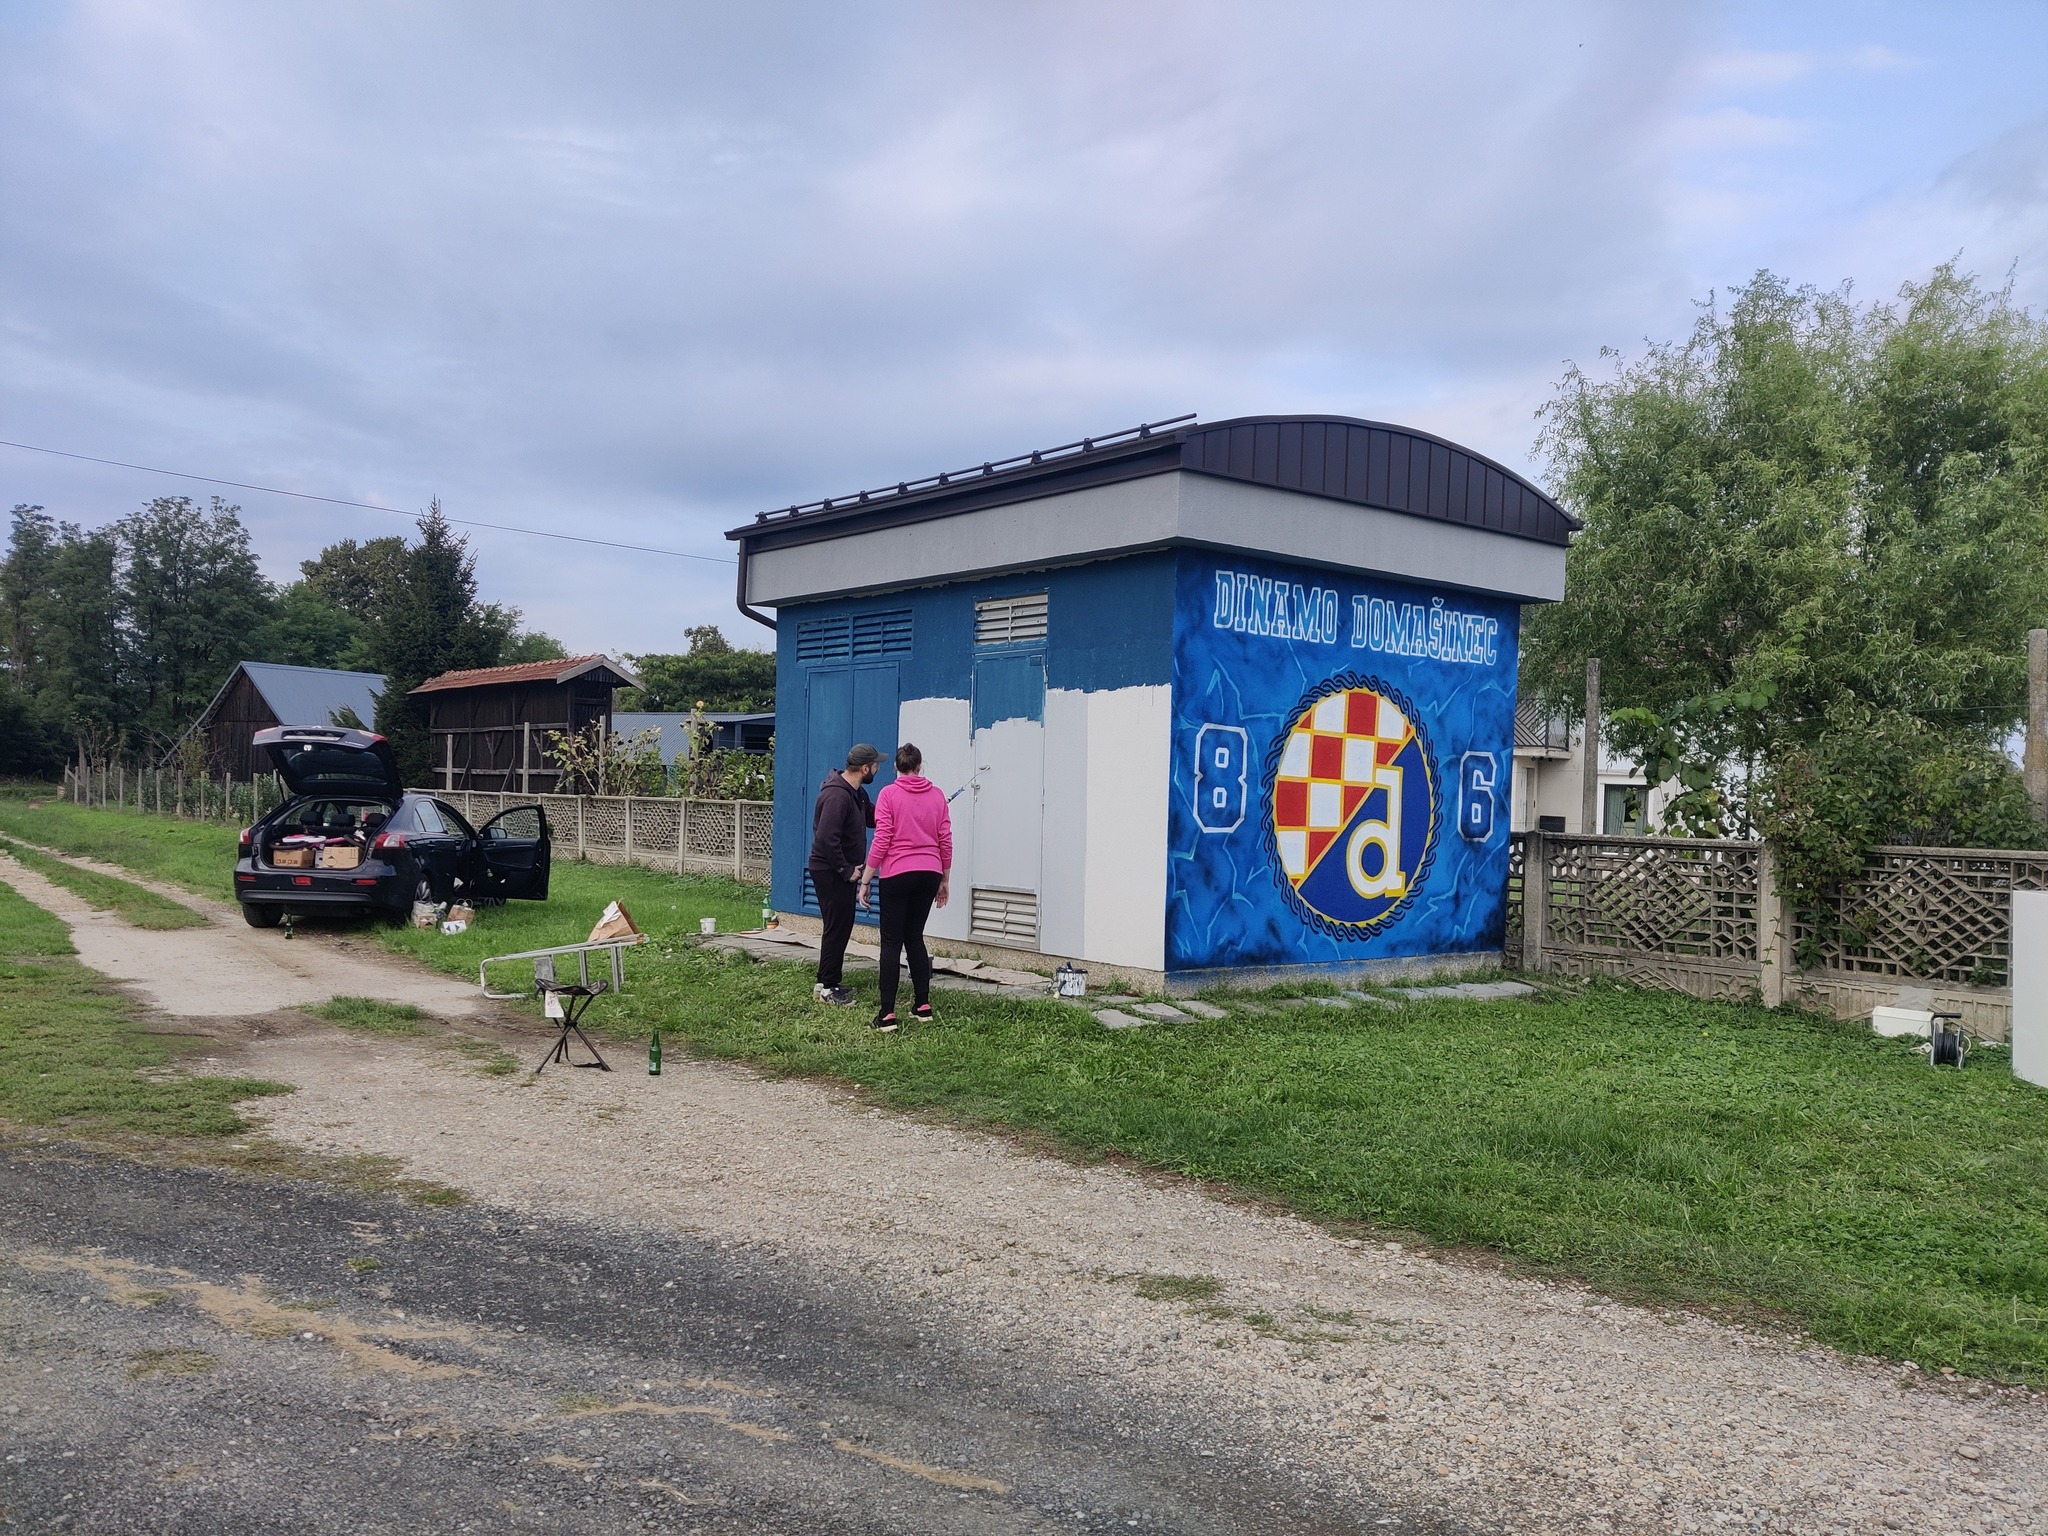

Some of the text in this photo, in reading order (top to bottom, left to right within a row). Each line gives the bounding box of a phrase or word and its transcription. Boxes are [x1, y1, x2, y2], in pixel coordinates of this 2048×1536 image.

[1213, 570, 1498, 666] DINAMO DOMAŠINEC
[1194, 723, 1247, 833] 8
[1458, 751, 1497, 842] 6
[1346, 765, 1405, 898] d
